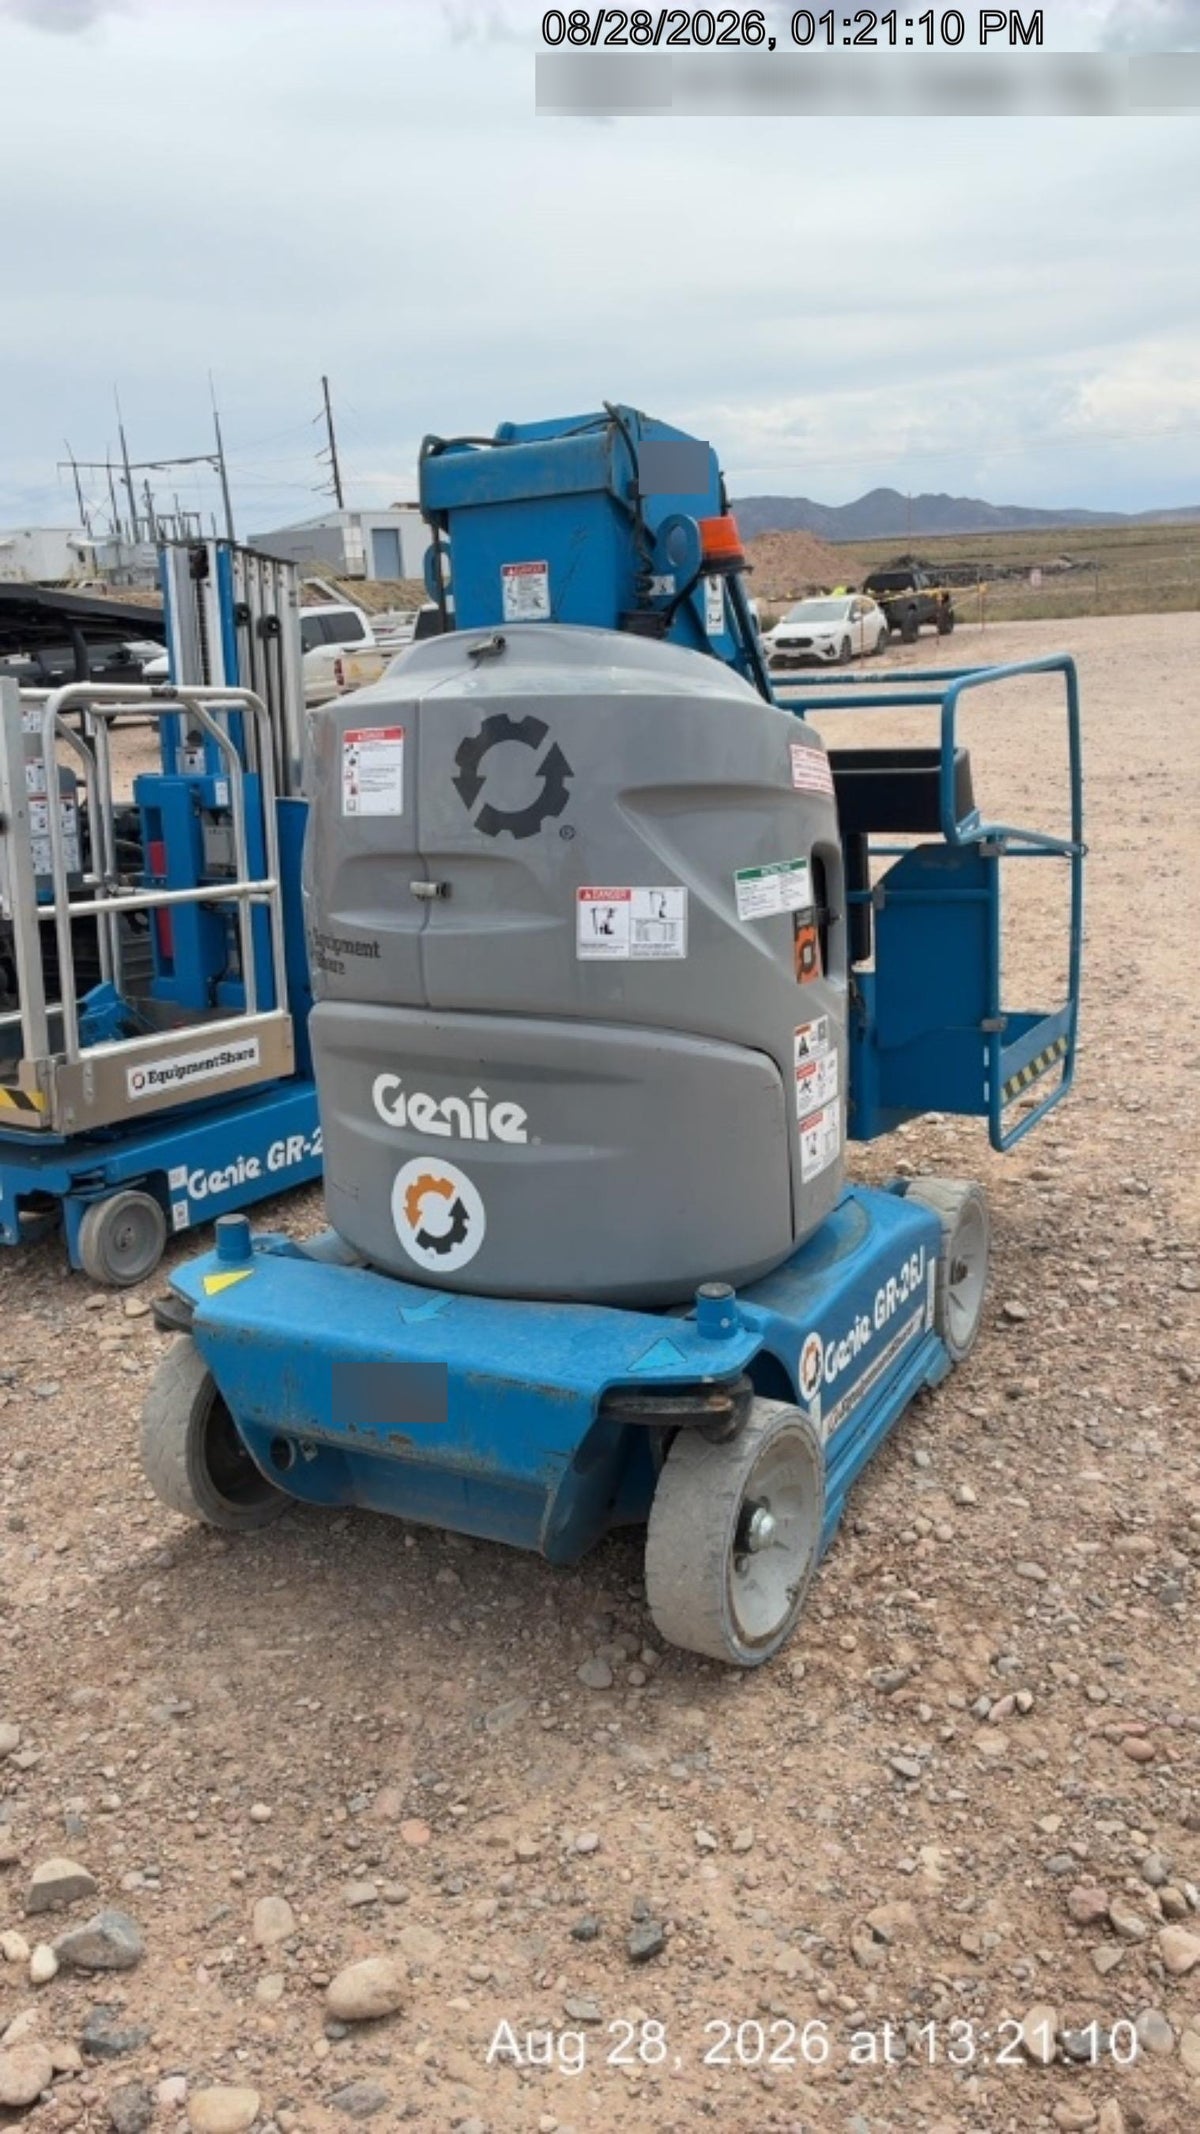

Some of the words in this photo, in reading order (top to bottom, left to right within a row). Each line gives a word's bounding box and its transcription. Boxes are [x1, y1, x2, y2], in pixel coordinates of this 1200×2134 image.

[147, 1050, 255, 1085] EquipmentShare
[372, 1073, 528, 1144] Genie
[187, 1155, 263, 1200] Genie
[824, 1313, 872, 1384] Genie
[874, 1244, 926, 1331] GR-26J
